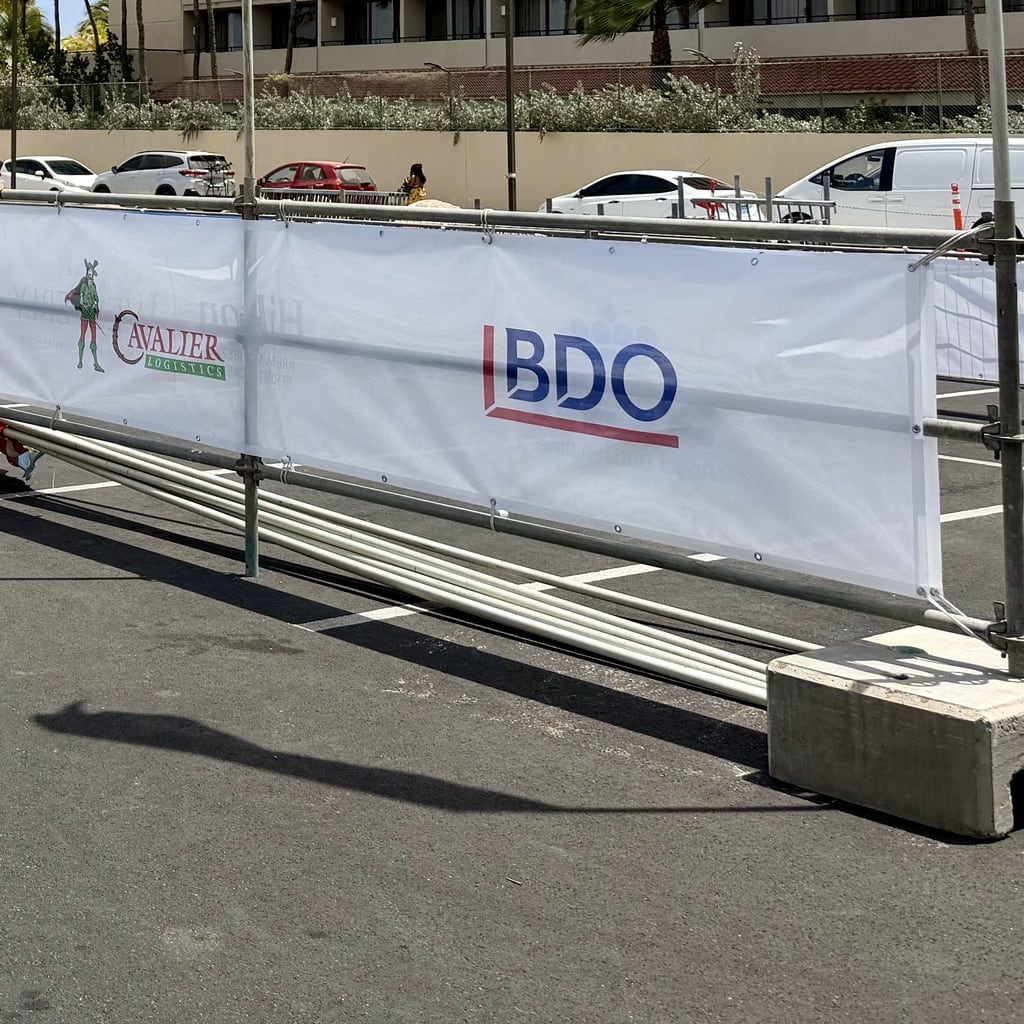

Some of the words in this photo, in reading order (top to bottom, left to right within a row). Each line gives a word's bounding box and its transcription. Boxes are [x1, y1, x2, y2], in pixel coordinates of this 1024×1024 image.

[112, 309, 225, 365] CAVALIER
[147, 356, 223, 378] LOGISTICS
[505, 327, 678, 423] BDO
